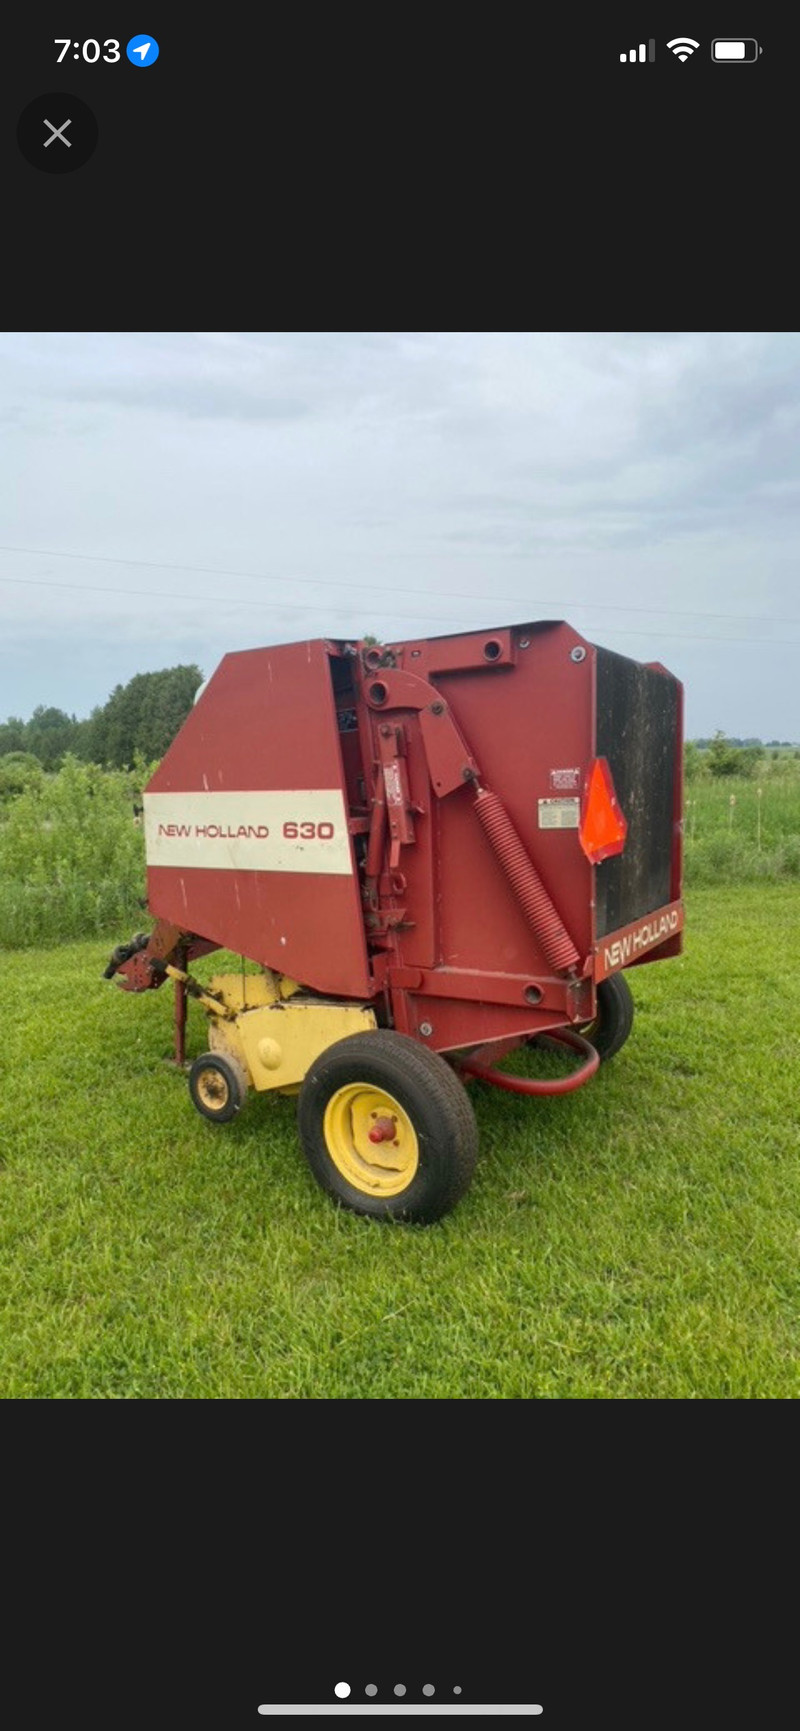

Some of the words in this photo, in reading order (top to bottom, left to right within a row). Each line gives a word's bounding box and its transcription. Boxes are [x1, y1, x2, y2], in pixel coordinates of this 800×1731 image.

[158, 824, 191, 838] NEW
[196, 824, 270, 839] HOLLAND
[282, 821, 335, 840] 630
[604, 933, 633, 972] NEW
[632, 910, 679, 953] HOLLAND
